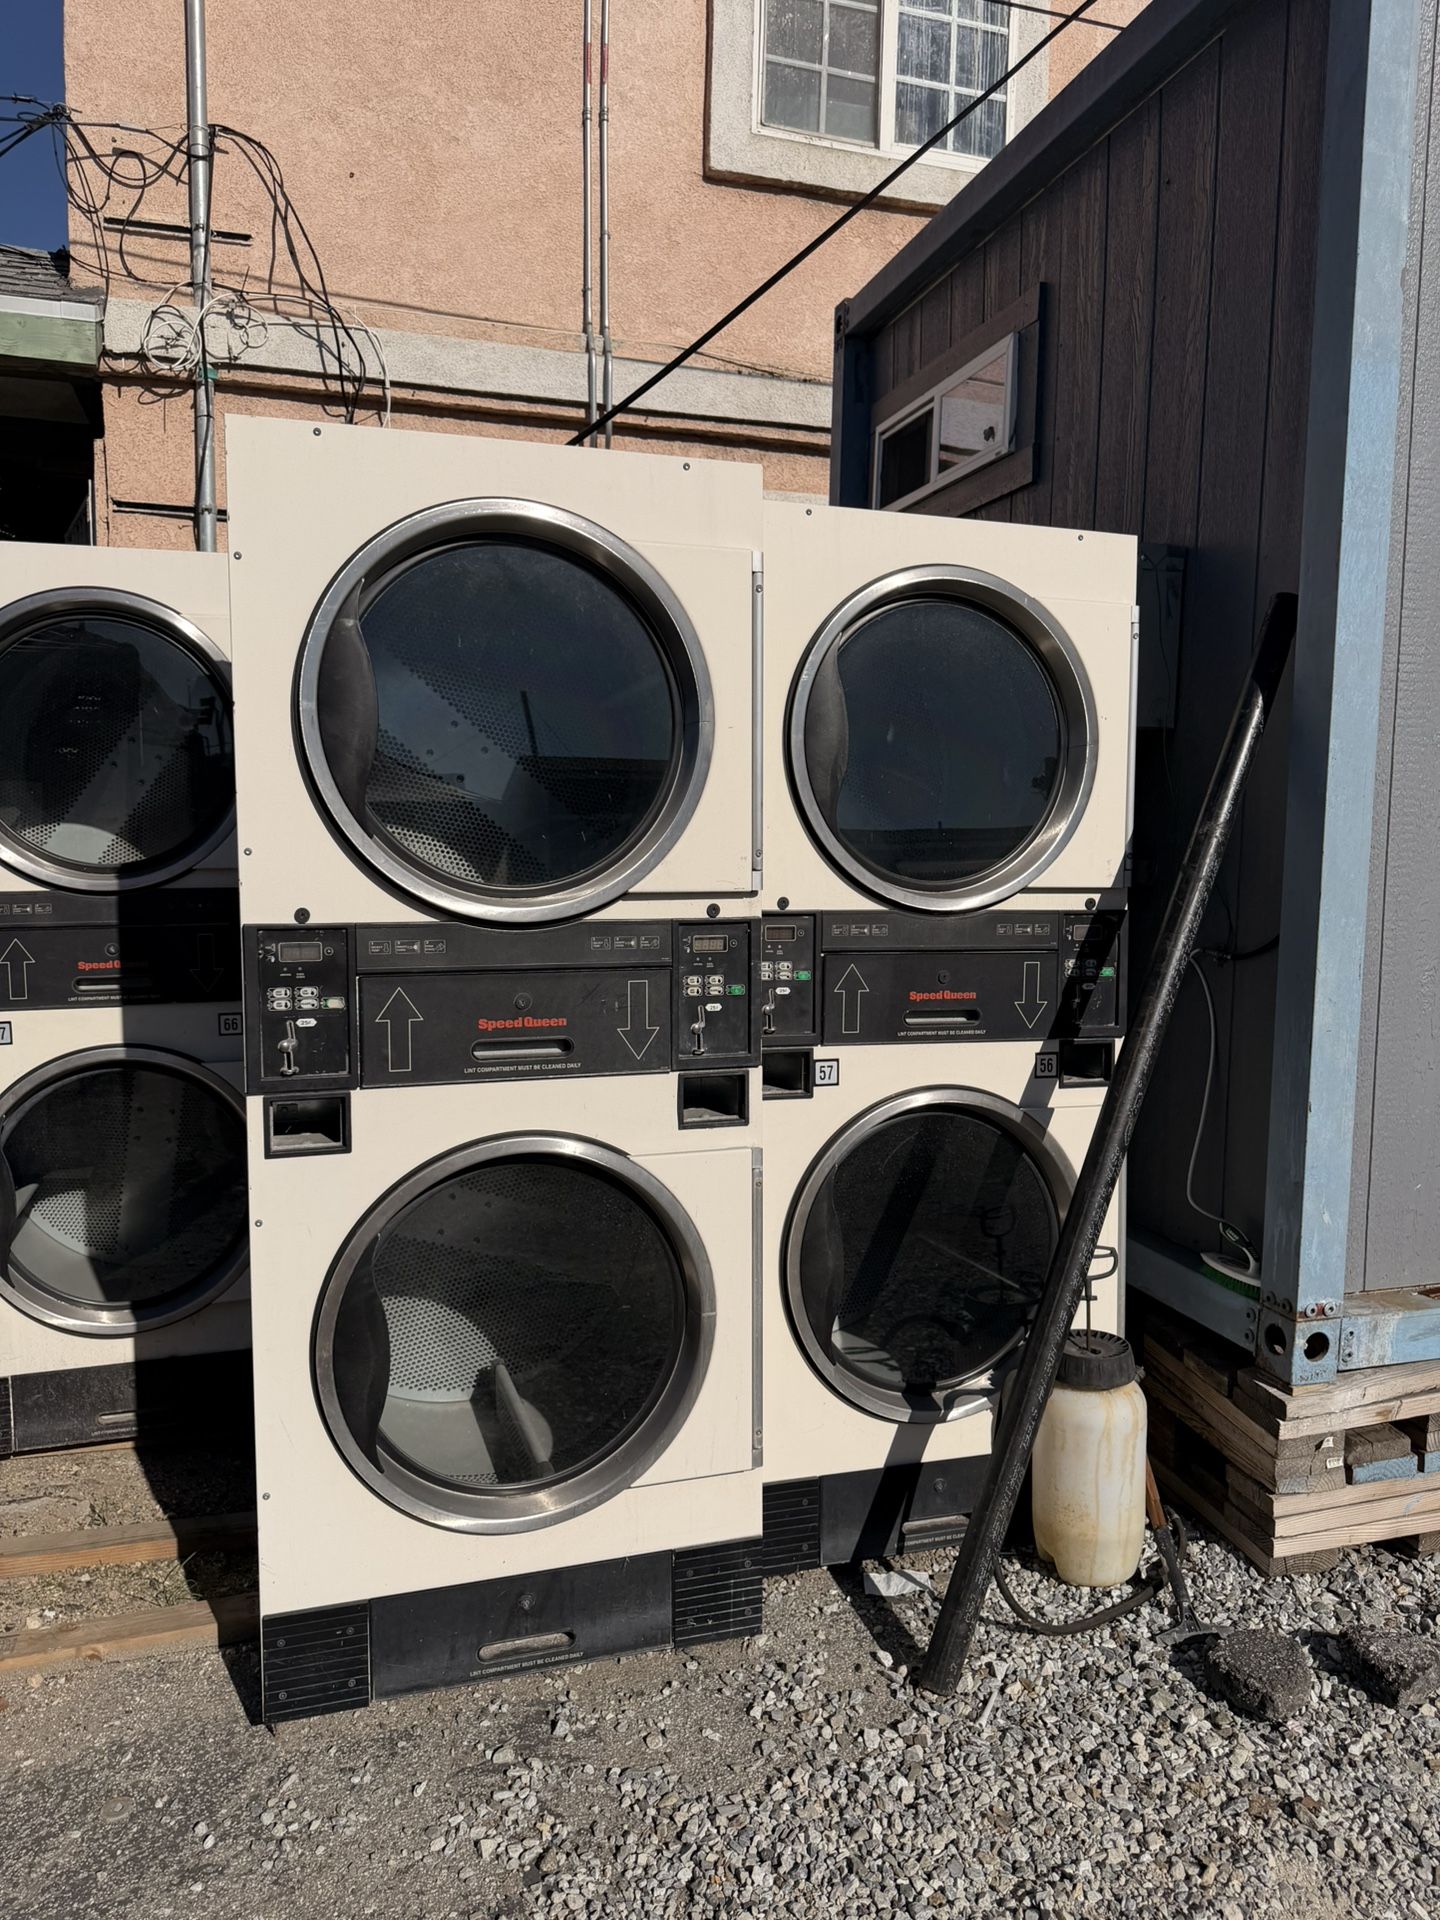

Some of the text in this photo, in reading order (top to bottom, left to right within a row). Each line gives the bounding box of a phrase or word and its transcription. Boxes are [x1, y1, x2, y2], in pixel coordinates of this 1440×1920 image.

[909, 990, 977, 1002] Speed Queen
[224, 1017, 238, 1031] 66
[478, 1016, 568, 1031] Speed Queen
[477, 1065, 518, 1073] COMPARTMENT
[819, 1065, 834, 1081] 57
[1039, 1058, 1054, 1073] 56
[482, 1663, 521, 1675] COMPARTMENT
[521, 1660, 536, 1668] MUST
[544, 1654, 569, 1664] CLEANED
[569, 1651, 584, 1660] DAILY
